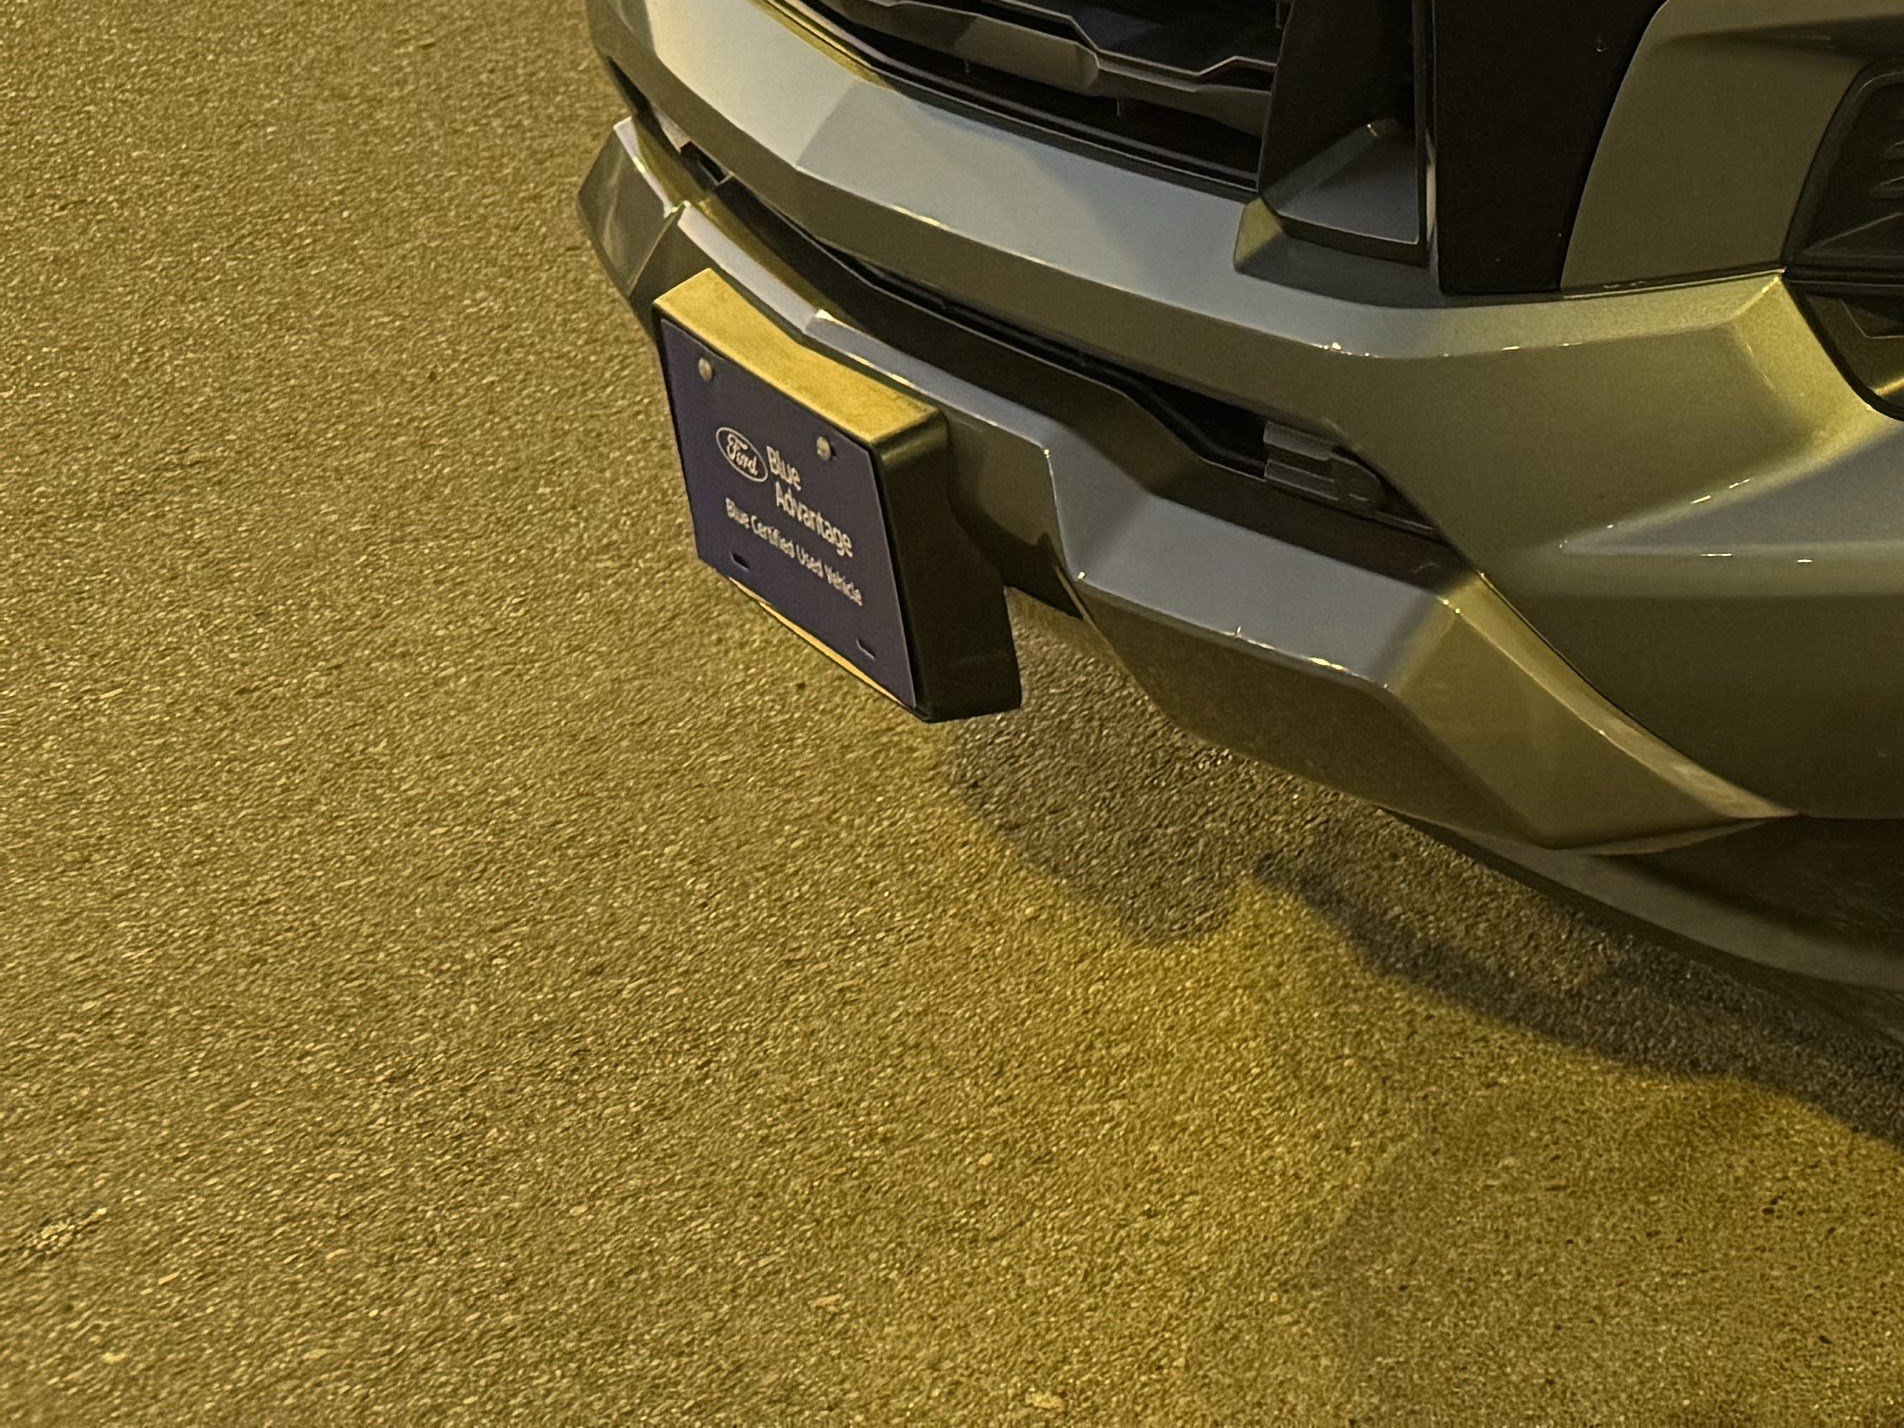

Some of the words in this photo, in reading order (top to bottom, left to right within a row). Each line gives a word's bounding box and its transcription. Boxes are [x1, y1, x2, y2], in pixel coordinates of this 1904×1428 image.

[727, 433, 758, 476] Ford
[766, 446, 801, 491] Blue
[775, 482, 853, 557] Advantage
[726, 498, 750, 528] Blue
[751, 515, 795, 558] Certified
[796, 544, 824, 578] Used
[824, 564, 863, 606] Vehicle
